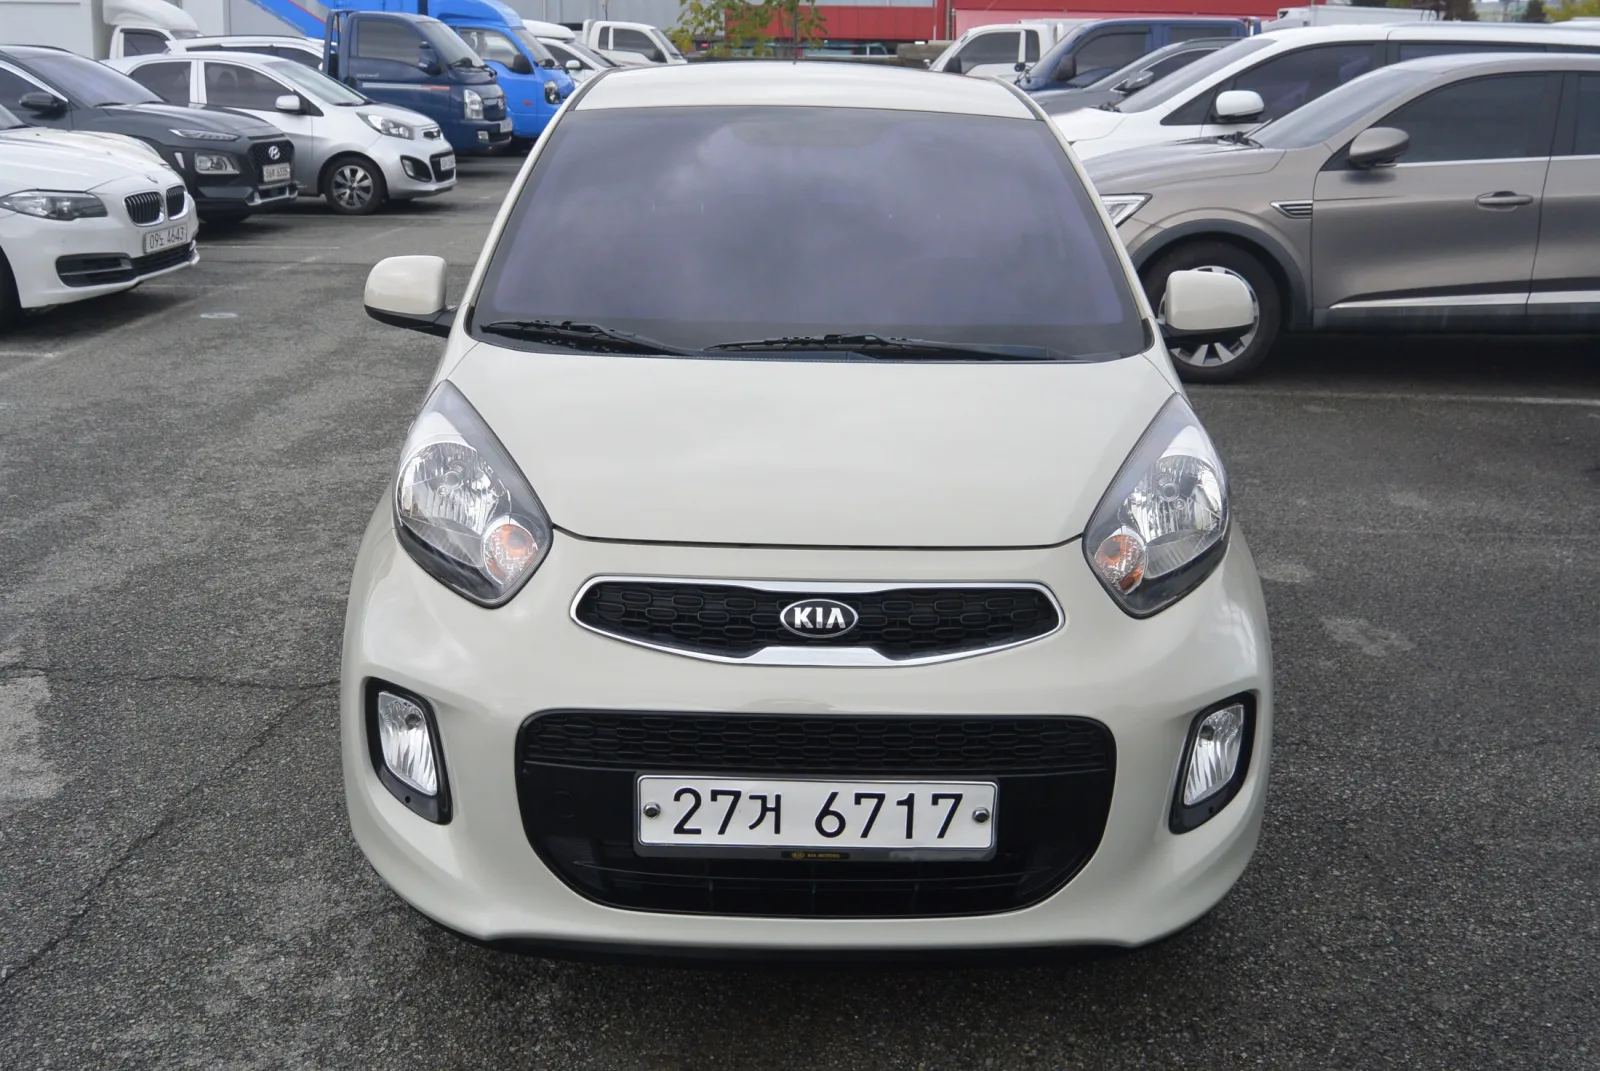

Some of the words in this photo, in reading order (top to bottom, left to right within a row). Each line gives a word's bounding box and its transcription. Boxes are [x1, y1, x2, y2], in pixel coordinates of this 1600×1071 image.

[167, 226, 184, 244] 4643
[794, 607, 846, 629] KIA
[673, 786, 782, 836] 27거
[814, 791, 964, 840] 6717
